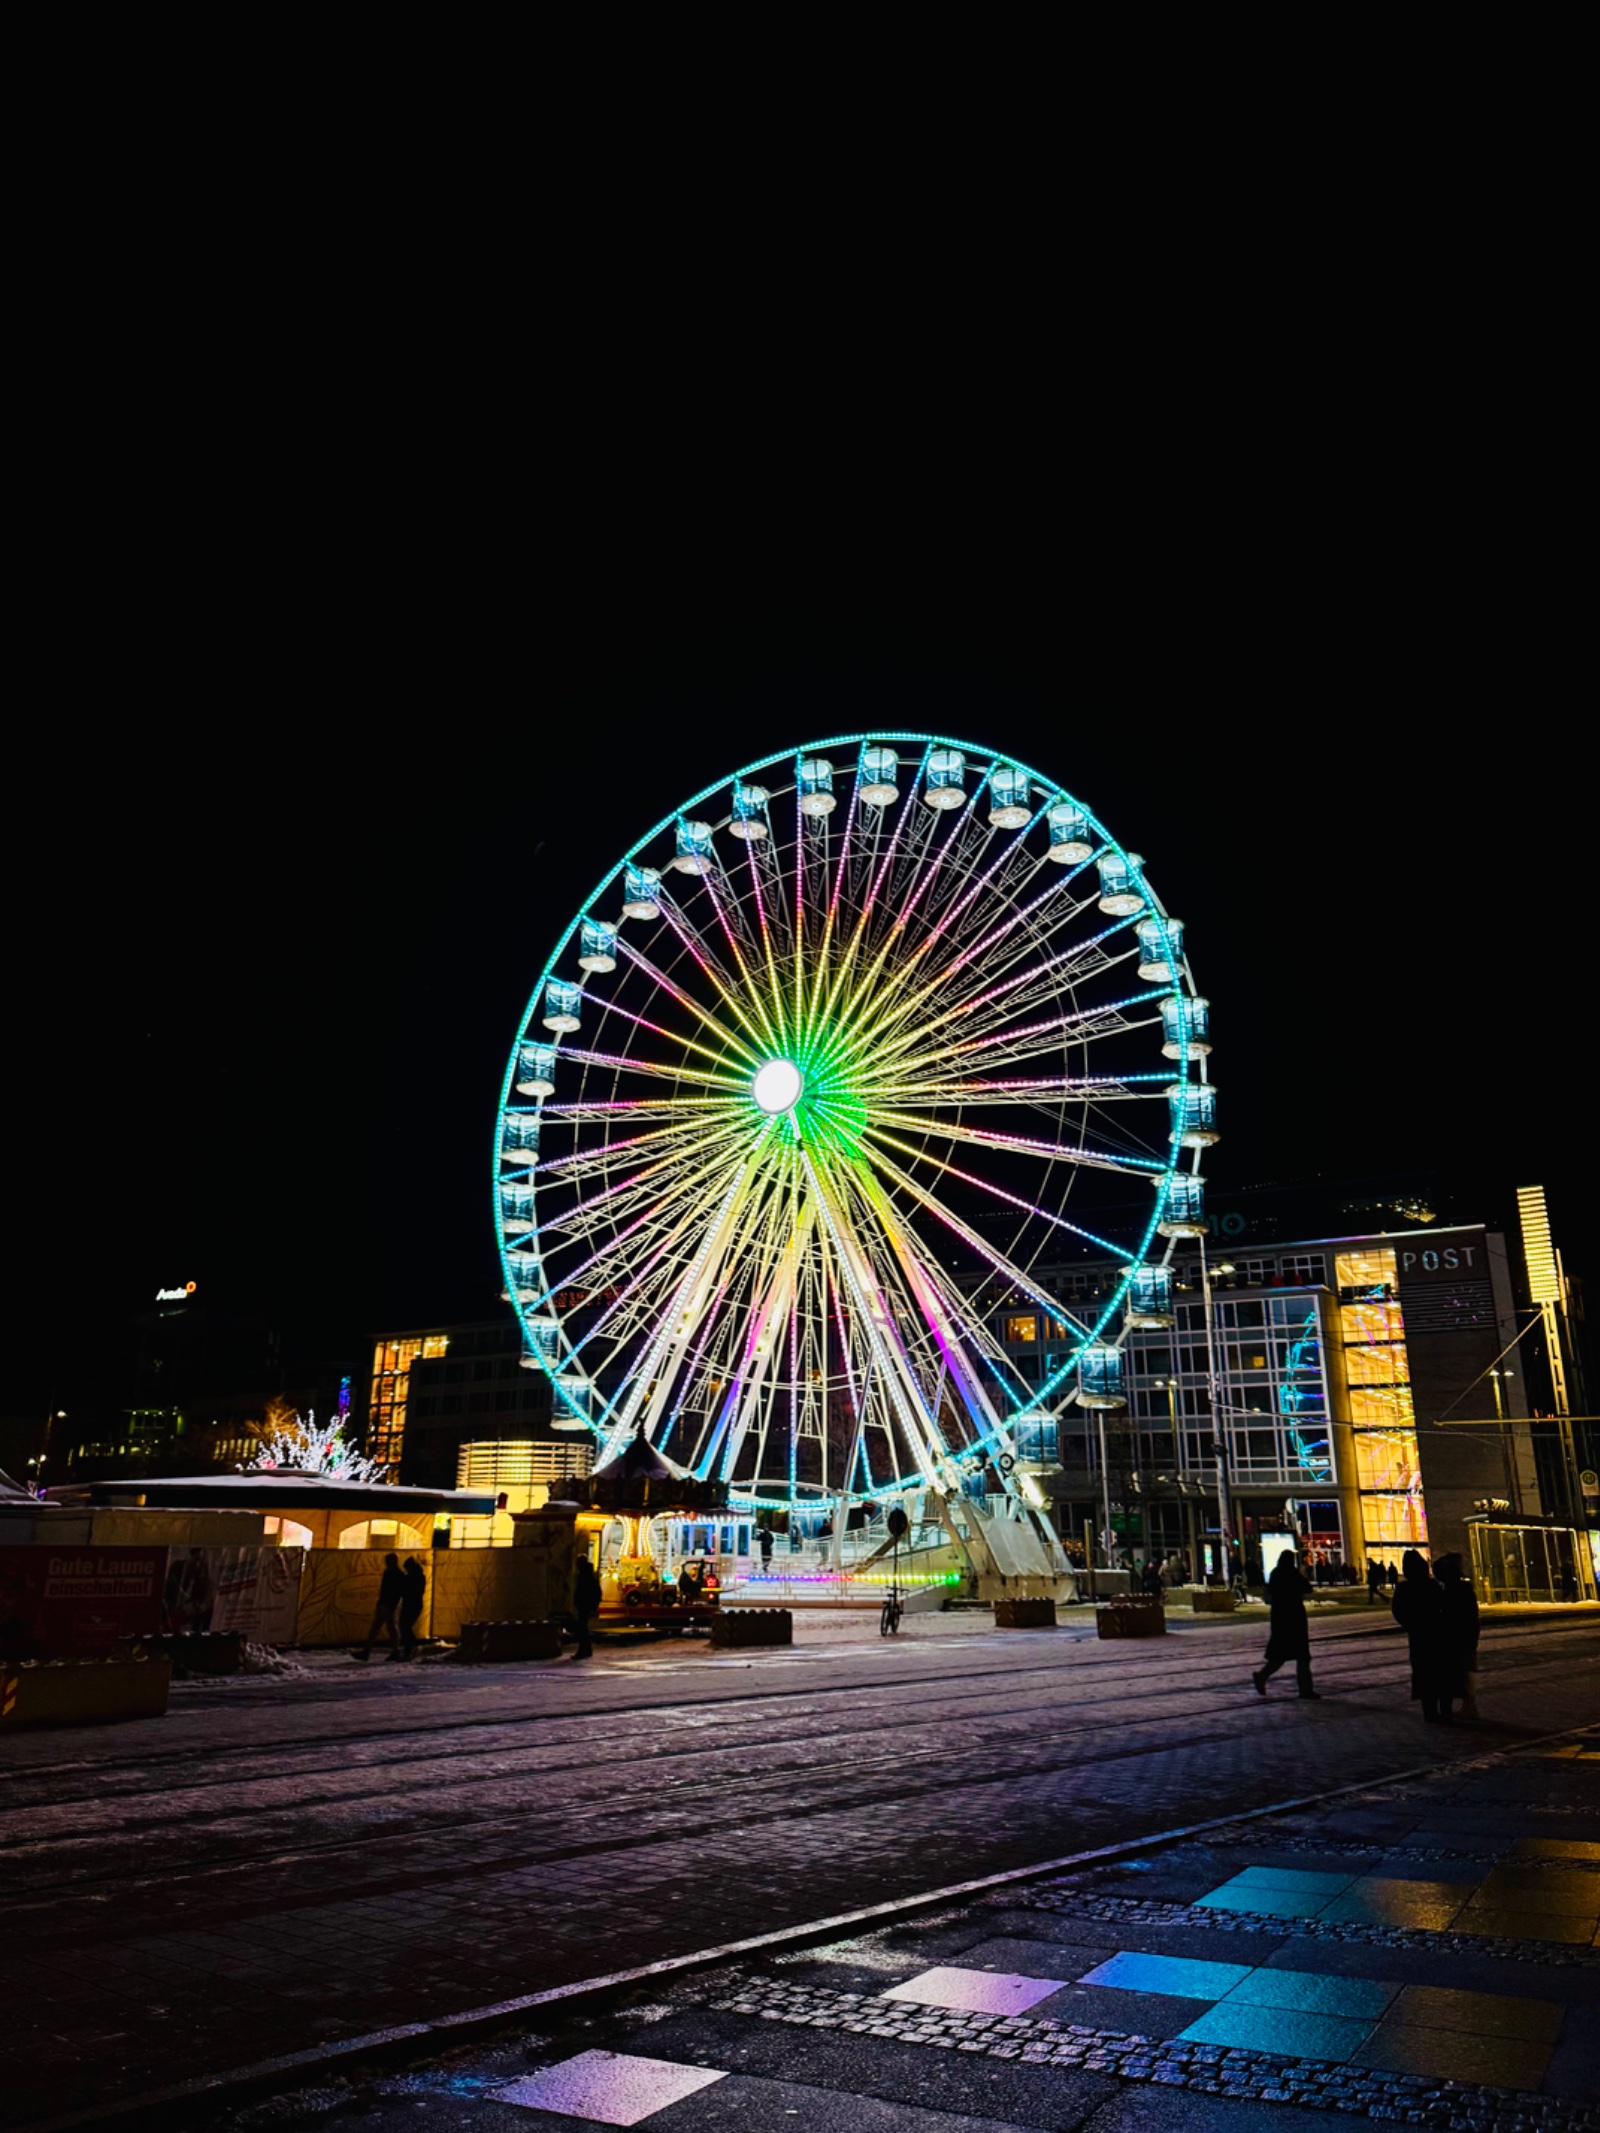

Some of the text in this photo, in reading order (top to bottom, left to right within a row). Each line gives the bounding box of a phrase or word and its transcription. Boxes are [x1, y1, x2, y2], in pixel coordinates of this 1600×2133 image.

[1402, 1246, 1475, 1273] POST
[48, 1557, 156, 1576] Gute Laune
[49, 1579, 149, 1596] einschalten!
